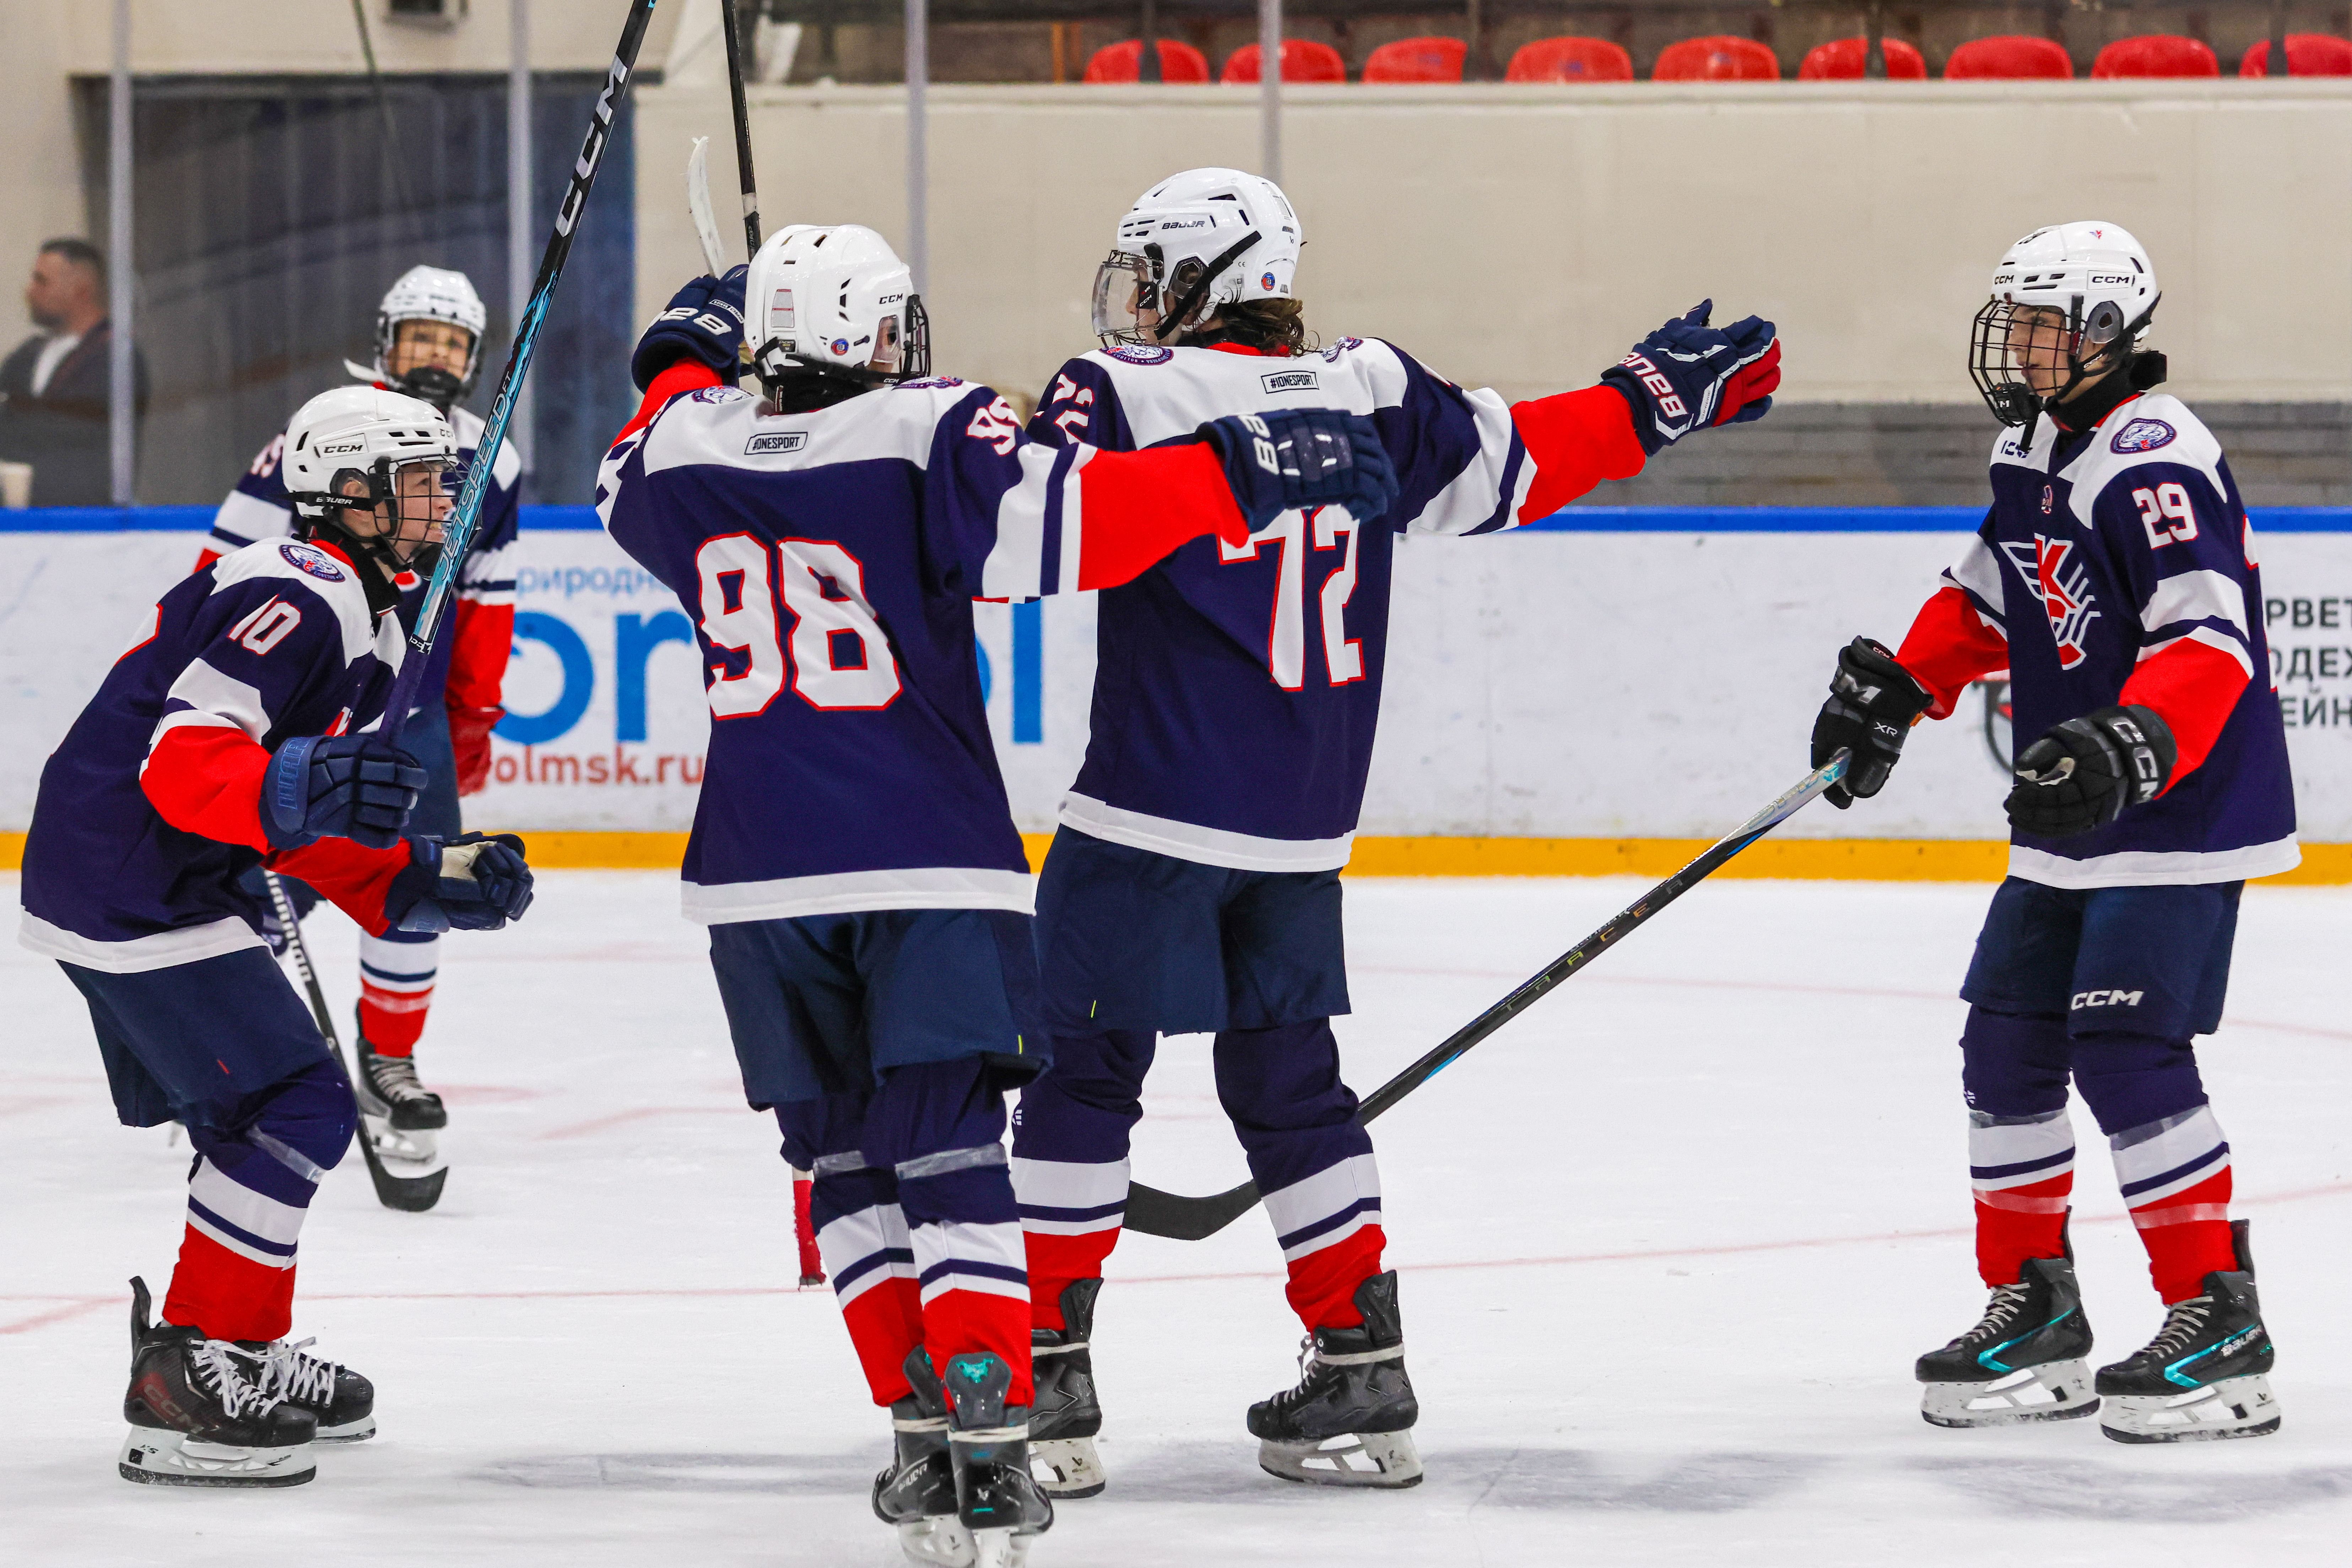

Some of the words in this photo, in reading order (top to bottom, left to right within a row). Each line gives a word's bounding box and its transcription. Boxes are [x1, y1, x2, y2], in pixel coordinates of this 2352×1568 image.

[556, 53, 627, 237] CCM
[1162, 220, 1205, 229] BAUER
[1994, 275, 2014, 285] CCM
[2092, 276, 2129, 284] CCM
[879, 293, 903, 304] CCM
[1139, 294, 1153, 307] CCM
[323, 444, 363, 454] CCM
[439, 393, 509, 580] JETSPEED
[2132, 482, 2200, 550] 29
[1216, 504, 1366, 692] 72
[227, 594, 301, 656] 10
[696, 533, 904, 721] 98
[1872, 646, 1890, 659] CCM
[2071, 989, 2144, 1010] CCM
